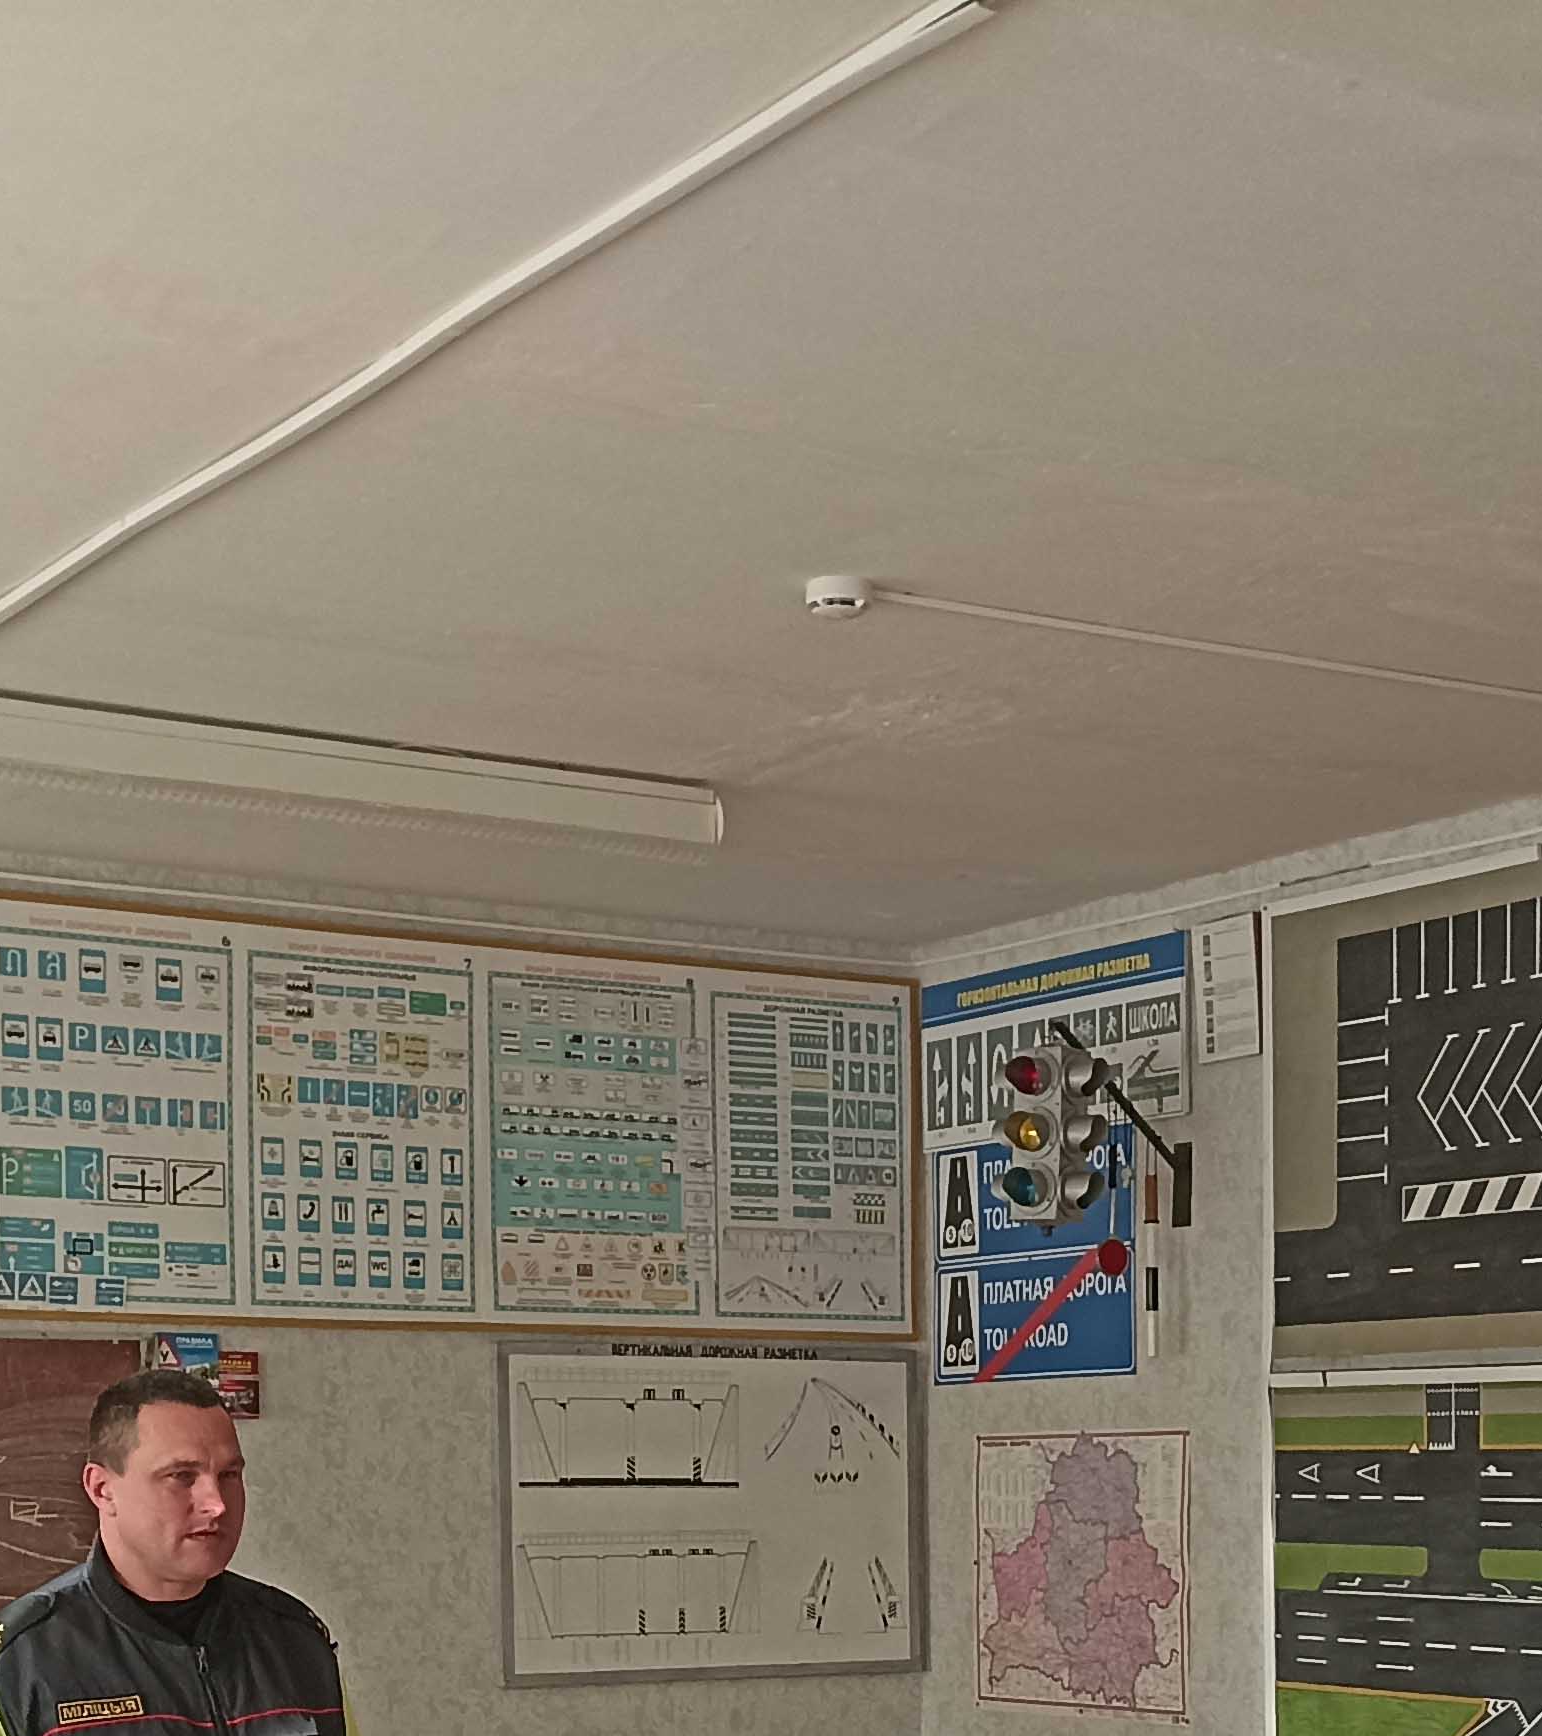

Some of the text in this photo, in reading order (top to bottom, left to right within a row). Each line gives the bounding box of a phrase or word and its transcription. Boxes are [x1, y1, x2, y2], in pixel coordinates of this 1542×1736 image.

[1096, 953, 1152, 978] РАЗМЕТКА
[1128, 1001, 1178, 1034] ШКОЛА
[72, 1099, 92, 1114] 50
[984, 1277, 1054, 1305] ПЛАТНАЯ
[611, 1343, 818, 1361] ВЕРТИКАЛЬНАЯ ДОРОЖНАЯ РАЗМЕТКА
[62, 1699, 138, 1719] МІЛІЦЫЯ
